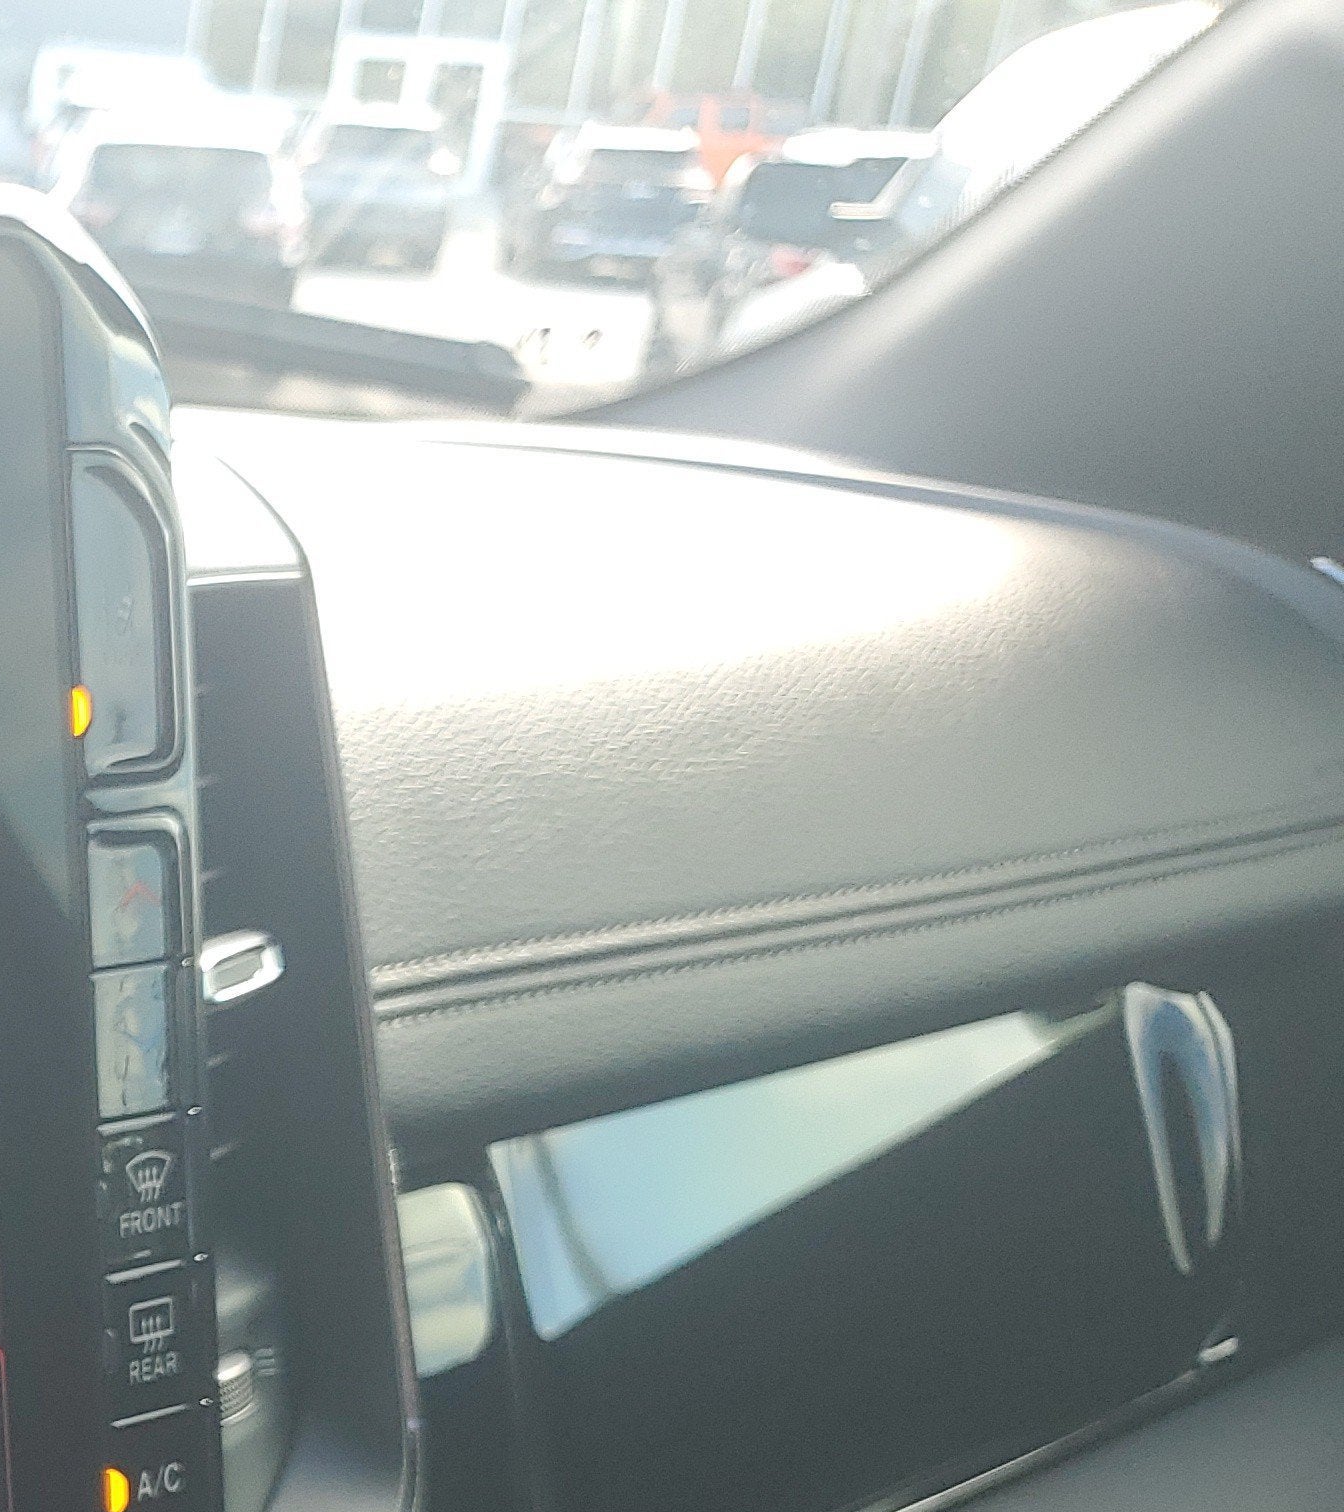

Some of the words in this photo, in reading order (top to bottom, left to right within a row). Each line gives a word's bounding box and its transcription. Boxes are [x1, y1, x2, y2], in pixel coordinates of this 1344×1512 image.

[120, 1202, 183, 1237] FRONT
[129, 1354, 178, 1384] REAR
[136, 1462, 185, 1500] A/C
